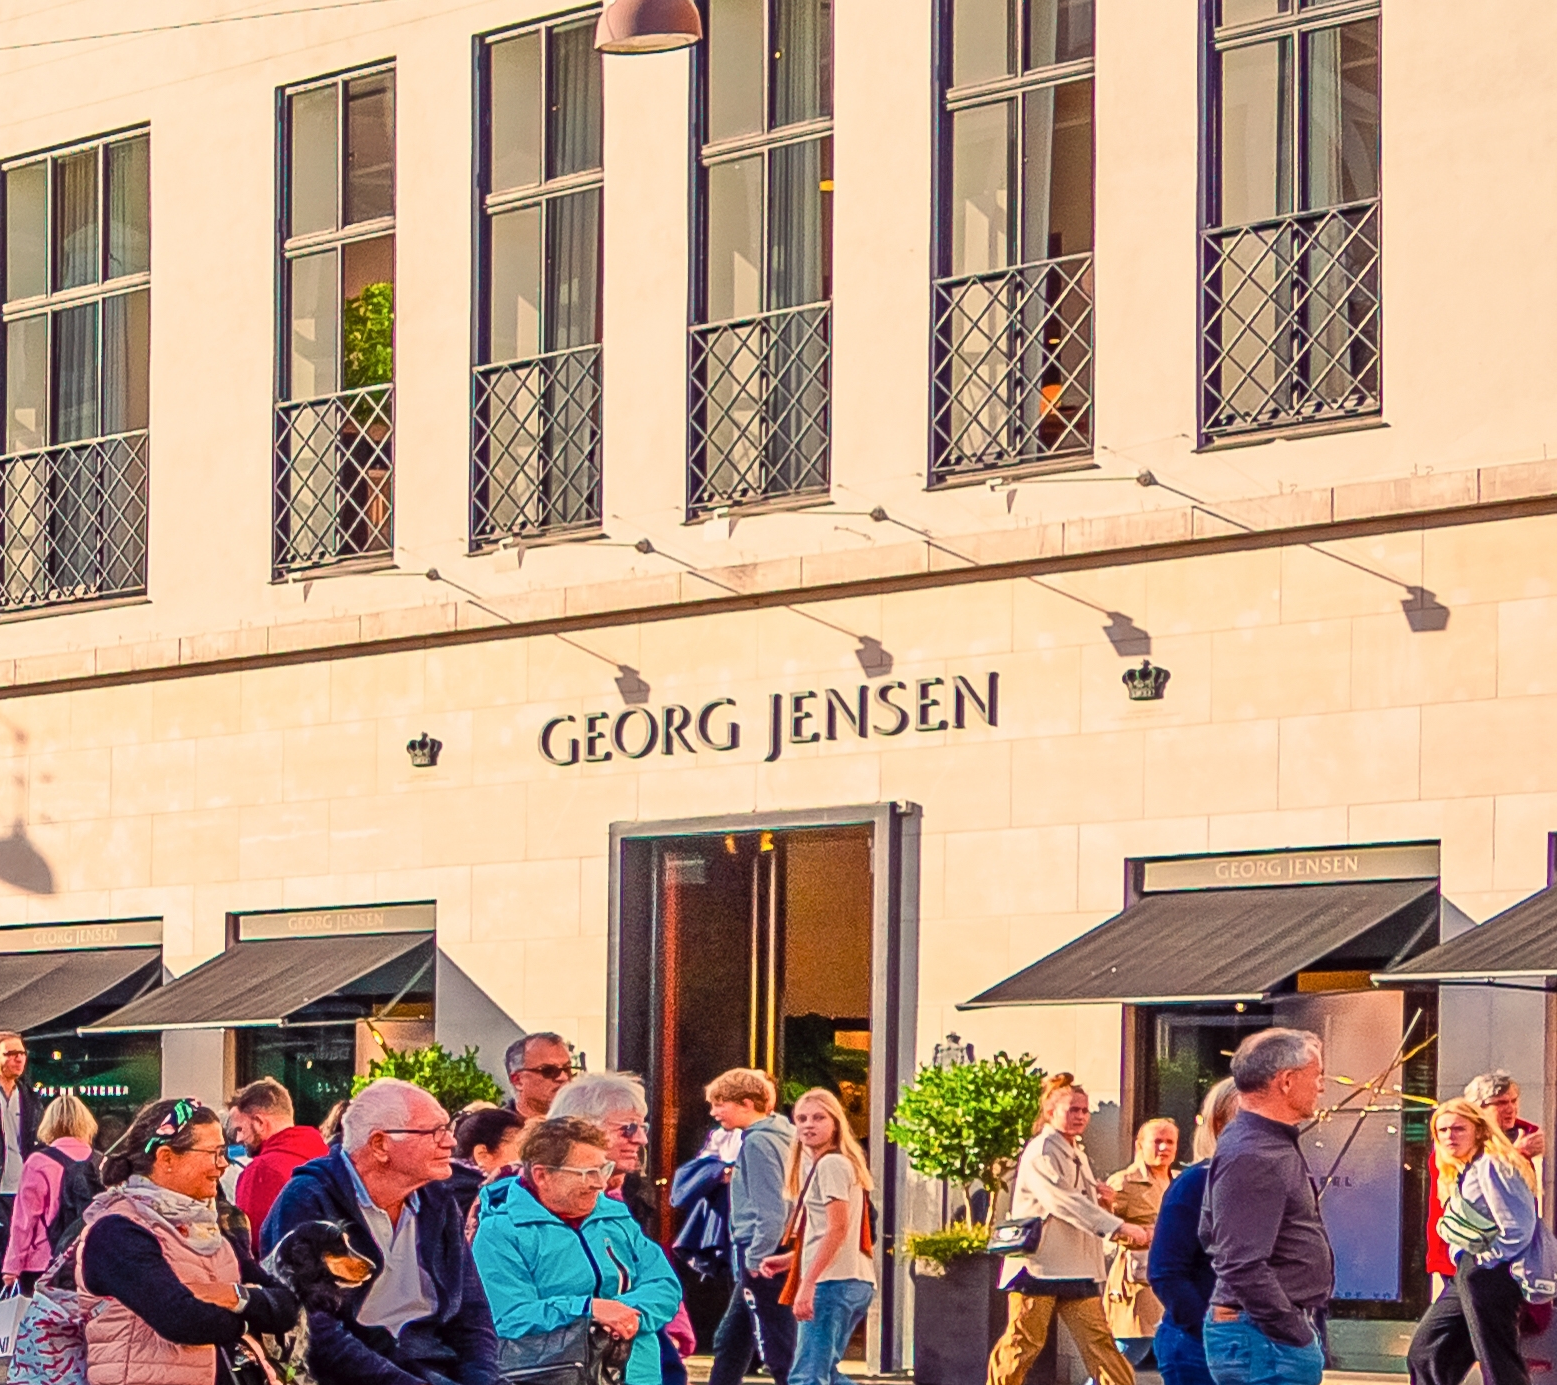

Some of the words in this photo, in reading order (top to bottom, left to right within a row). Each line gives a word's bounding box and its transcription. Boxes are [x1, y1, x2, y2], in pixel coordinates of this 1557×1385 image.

[537, 696, 741, 767] GEORG
[762, 670, 1001, 763] JENSEN
[1214, 858, 1283, 881] GEORG
[1286, 854, 1360, 880] JENSEN
[287, 913, 332, 931] GEORG
[334, 911, 385, 932] JENSEN
[32, 931, 73, 946] GEORG
[75, 928, 119, 947] JENSEN
